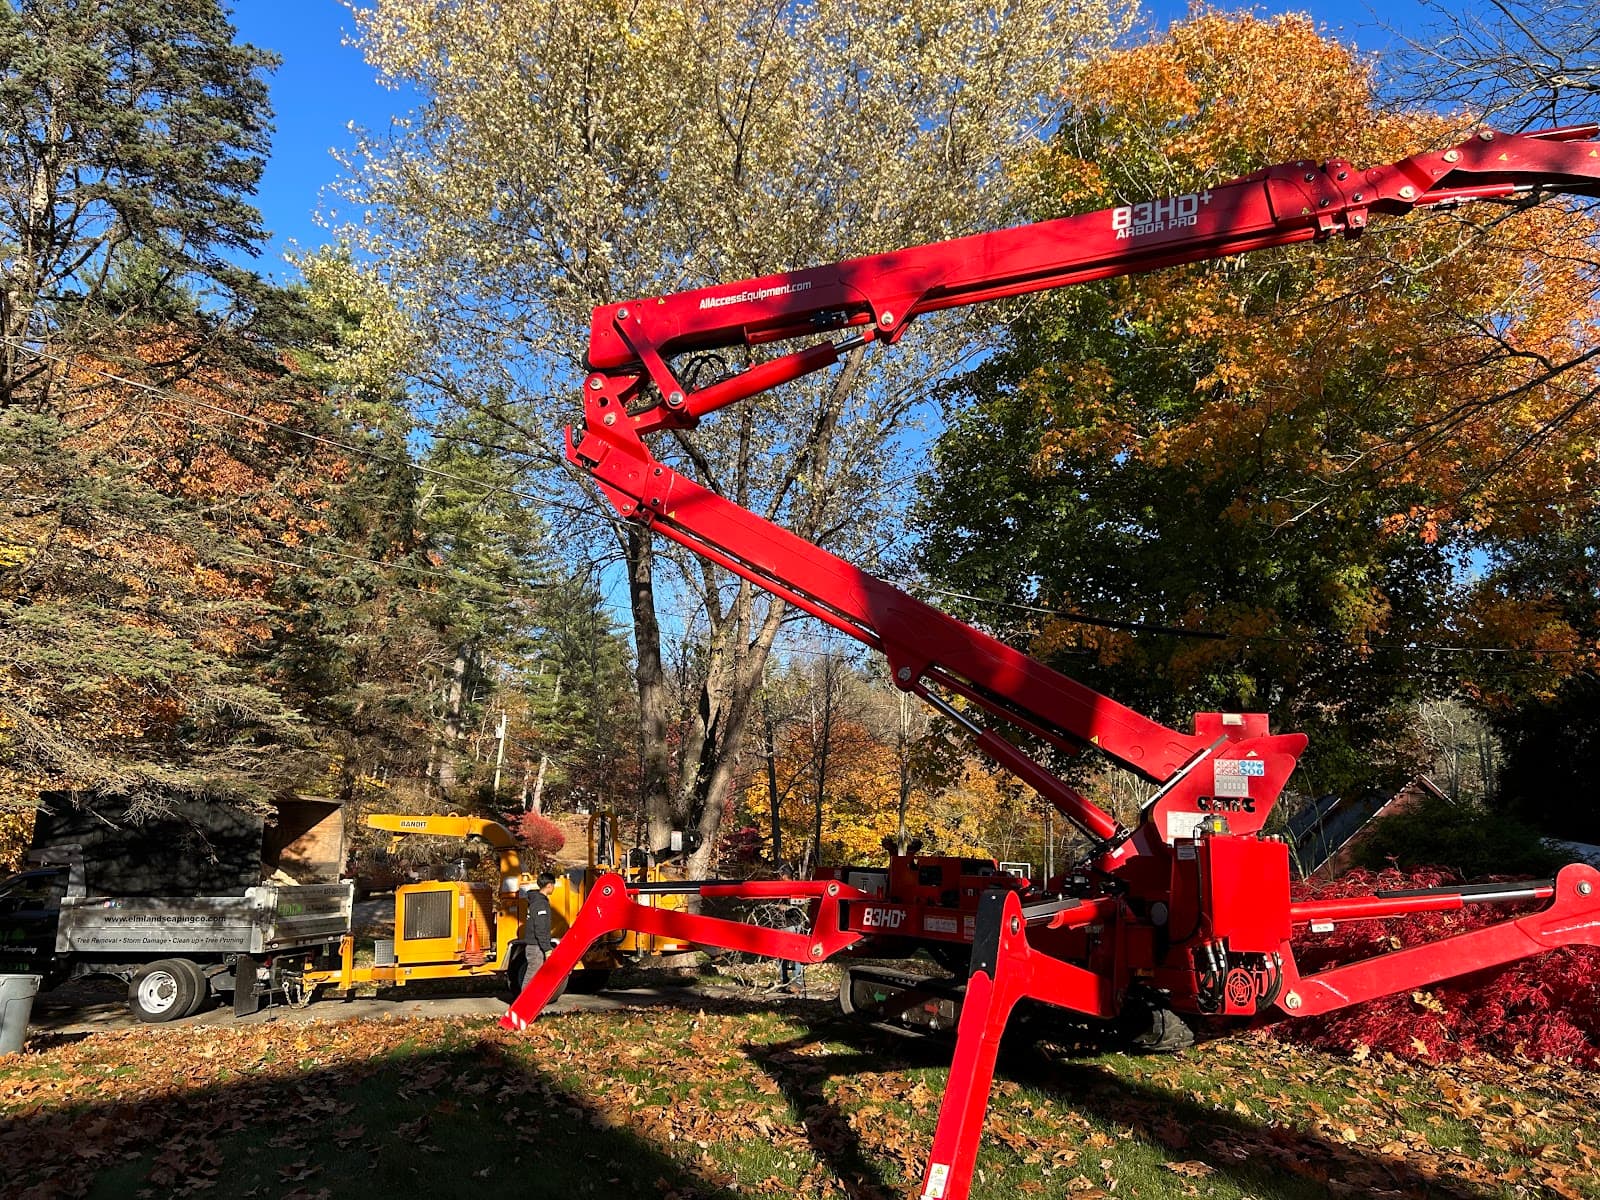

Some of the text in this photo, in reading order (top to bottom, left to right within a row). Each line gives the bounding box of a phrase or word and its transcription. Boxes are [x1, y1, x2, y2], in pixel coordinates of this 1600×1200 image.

[1116, 215, 1198, 240] ARBOR PRO
[699, 280, 812, 310] AllAccessEquipment.com
[104, 914, 226, 924] www.elmlandscapingco.com
[142, 937, 168, 945] Damage
